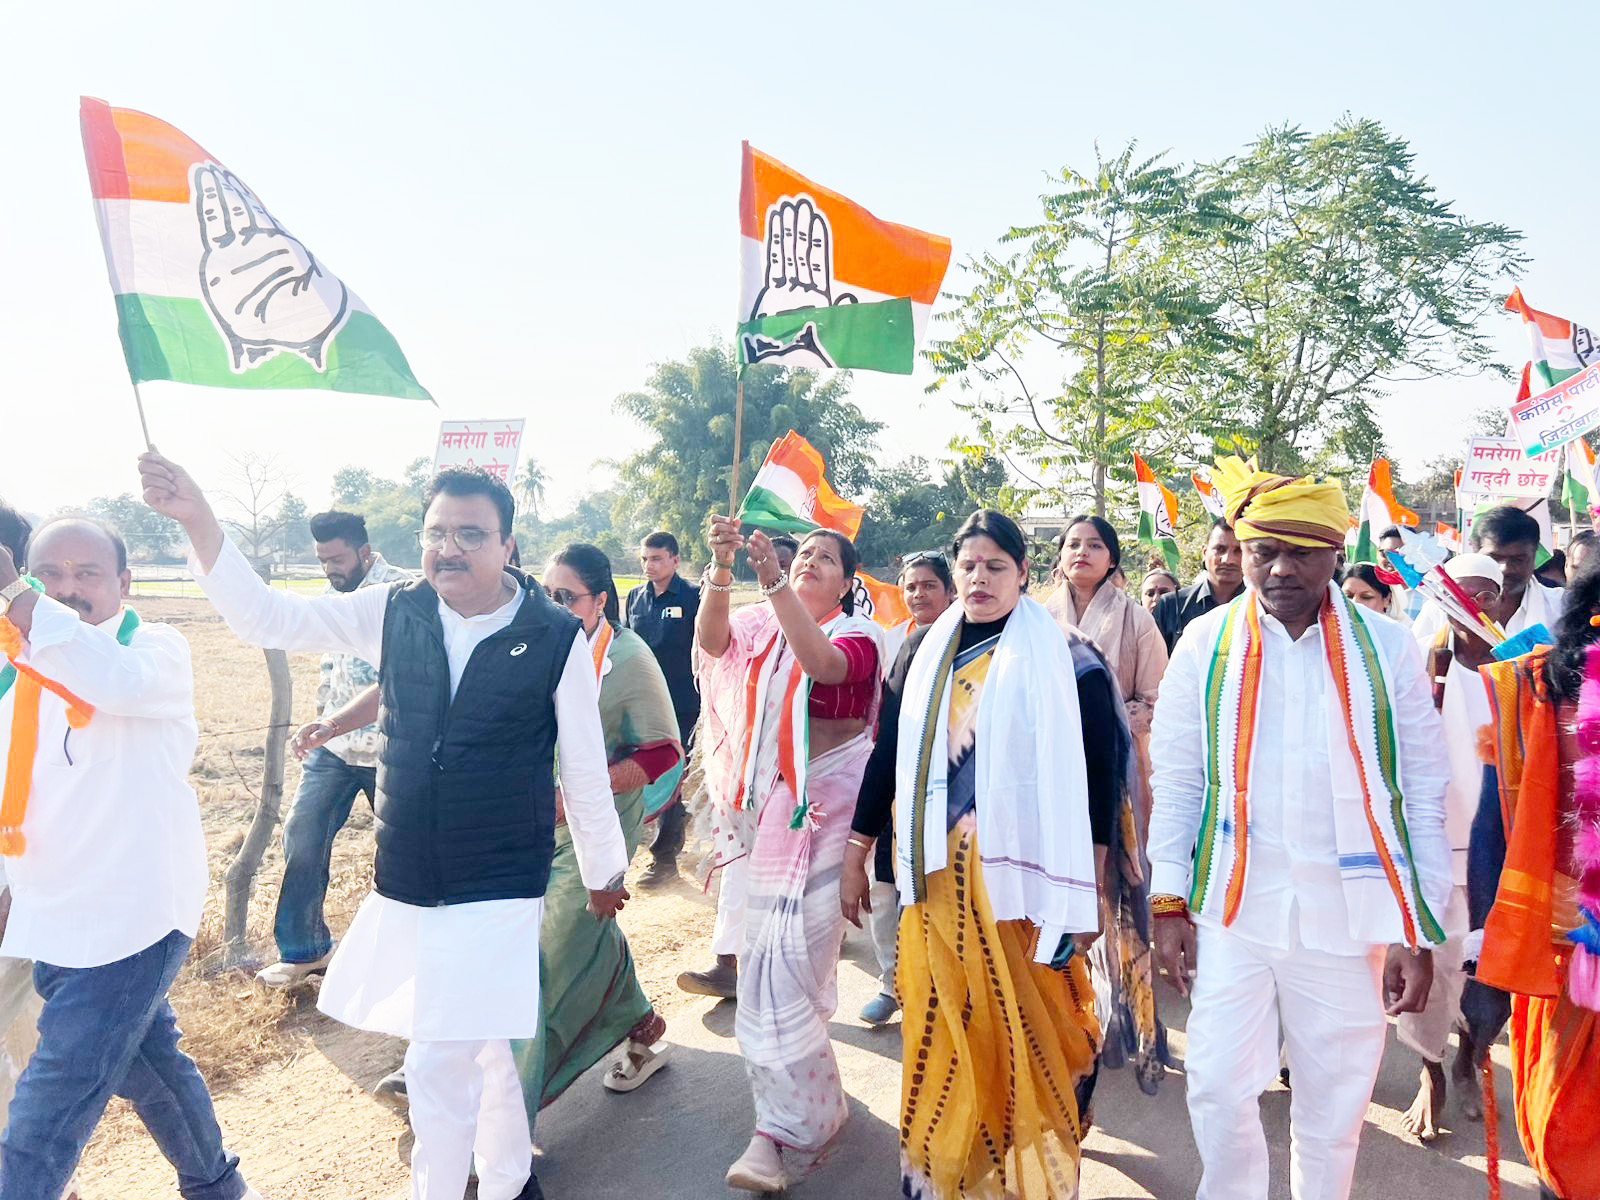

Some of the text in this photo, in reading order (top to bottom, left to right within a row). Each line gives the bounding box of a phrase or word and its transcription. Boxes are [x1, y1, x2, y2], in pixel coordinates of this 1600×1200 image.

[1518, 368, 1600, 422] कांग्रेस पार्टी
[441, 424, 520, 449] मनरेगा चोर
[1473, 443, 1521, 461] मनरेगा
[1517, 468, 1549, 492] छोड़
